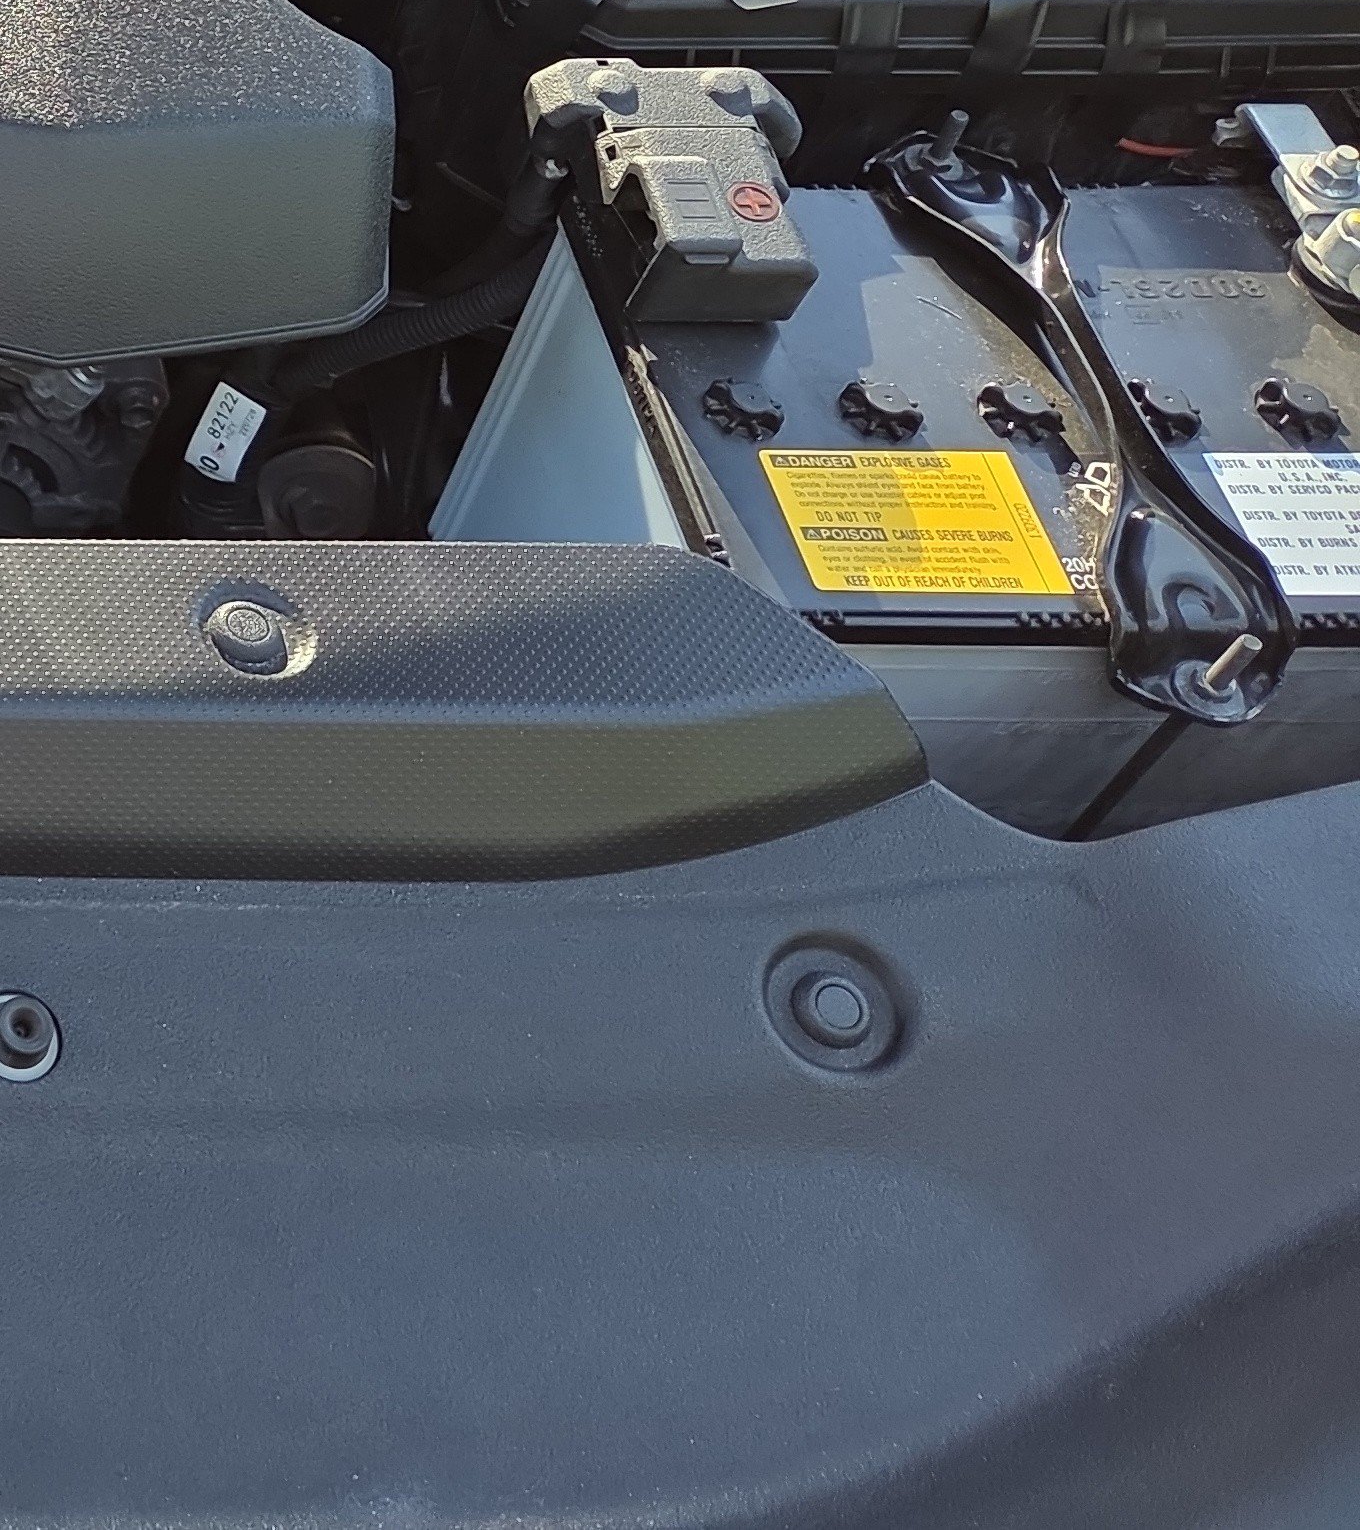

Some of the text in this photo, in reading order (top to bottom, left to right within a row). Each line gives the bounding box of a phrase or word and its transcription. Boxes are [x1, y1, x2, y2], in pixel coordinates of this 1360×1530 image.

[206, 391, 239, 439] 82122
[787, 456, 951, 468] DANGER EXPLOSIVE GASES
[1214, 459, 1360, 469] DISTR. BY TOYOTA MOTOR
[1228, 484, 1265, 495] DISTR.
[1268, 484, 1285, 495] BY
[815, 511, 882, 522] DO NOT TIP
[1243, 510, 1280, 521] DISTR.
[1283, 510, 1299, 521] BY
[1301, 510, 1346, 521] TOYOTA
[820, 529, 1014, 542] POISON CAUSES SEVERE BURNS
[1257, 537, 1358, 548] DISTR. BY BURNS
[1314, 565, 1330, 576] BY
[844, 575, 1024, 589] KEEP OUT OF REACH OF CHILDREN
